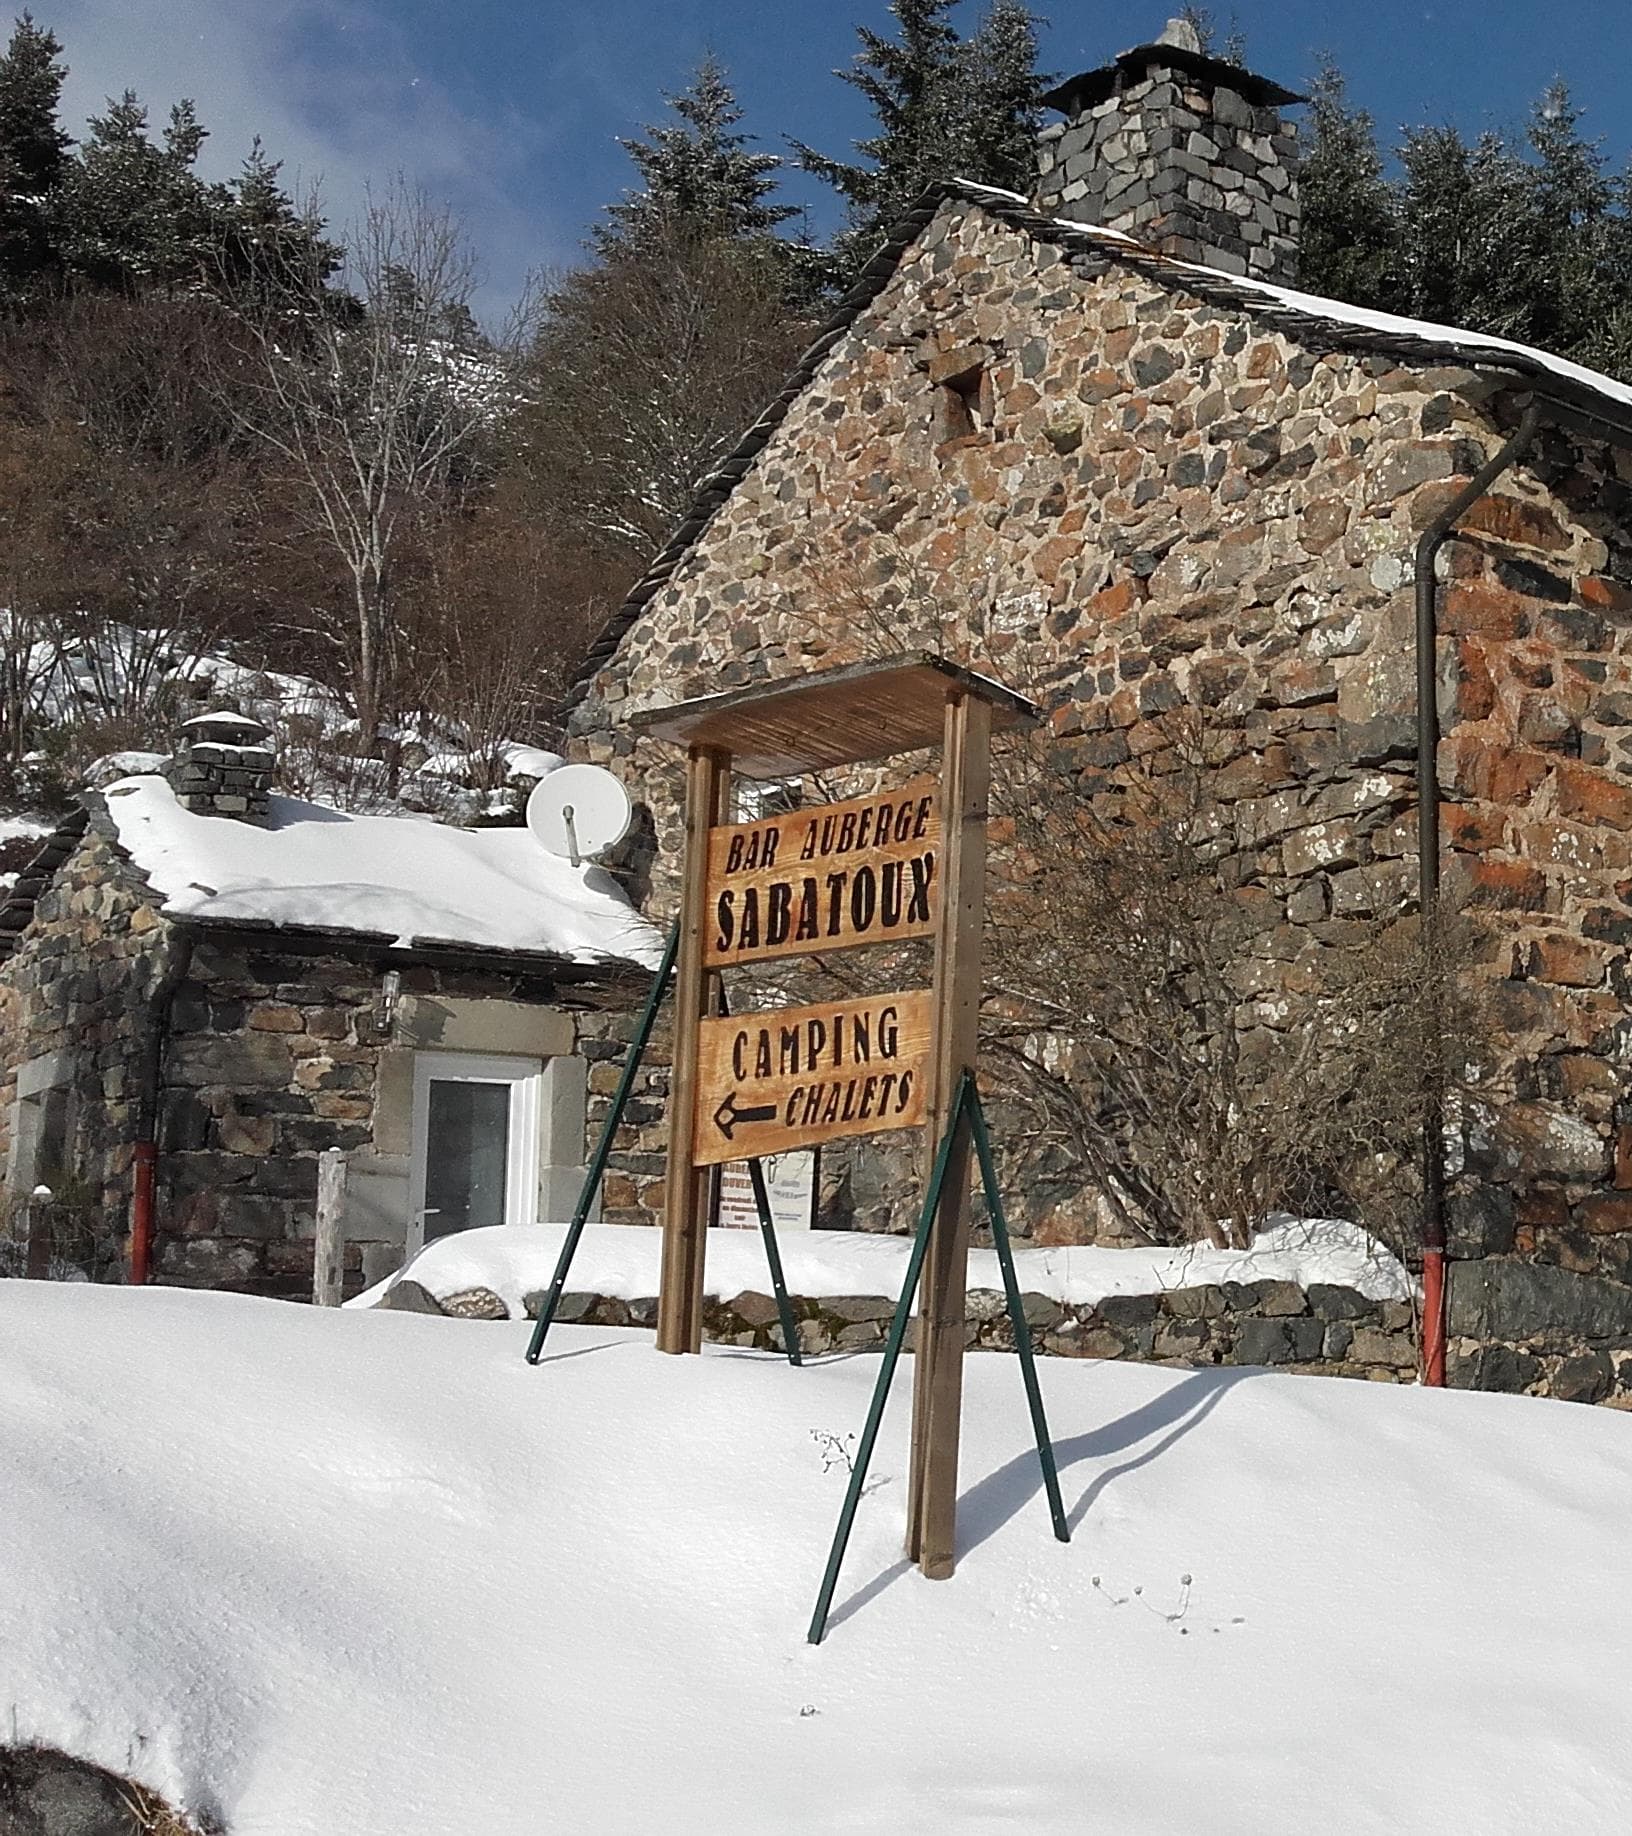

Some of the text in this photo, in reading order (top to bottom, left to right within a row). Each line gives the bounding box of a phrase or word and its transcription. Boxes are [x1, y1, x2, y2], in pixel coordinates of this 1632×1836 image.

[725, 796, 933, 874] BAR AUBERGE
[716, 851, 935, 952] SABATOUX
[732, 1006, 899, 1082] CAMPING
[785, 1069, 913, 1127] CHALETS
